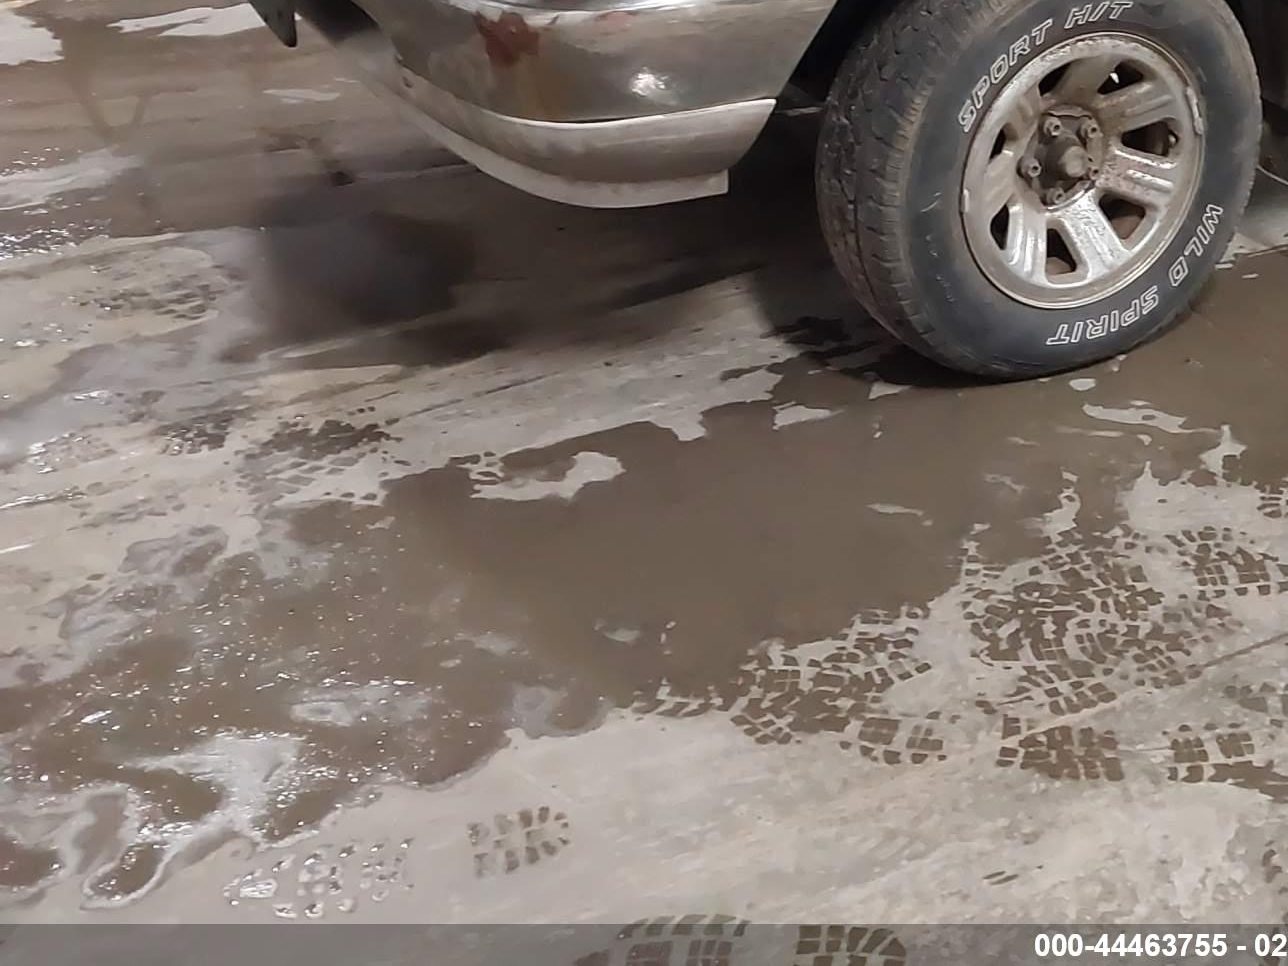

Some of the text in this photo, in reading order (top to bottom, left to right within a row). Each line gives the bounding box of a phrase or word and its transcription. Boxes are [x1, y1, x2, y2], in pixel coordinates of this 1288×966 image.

[958, 18, 1054, 133] SPORT
[1046, 203, 1225, 347] WILD SPIRIT
